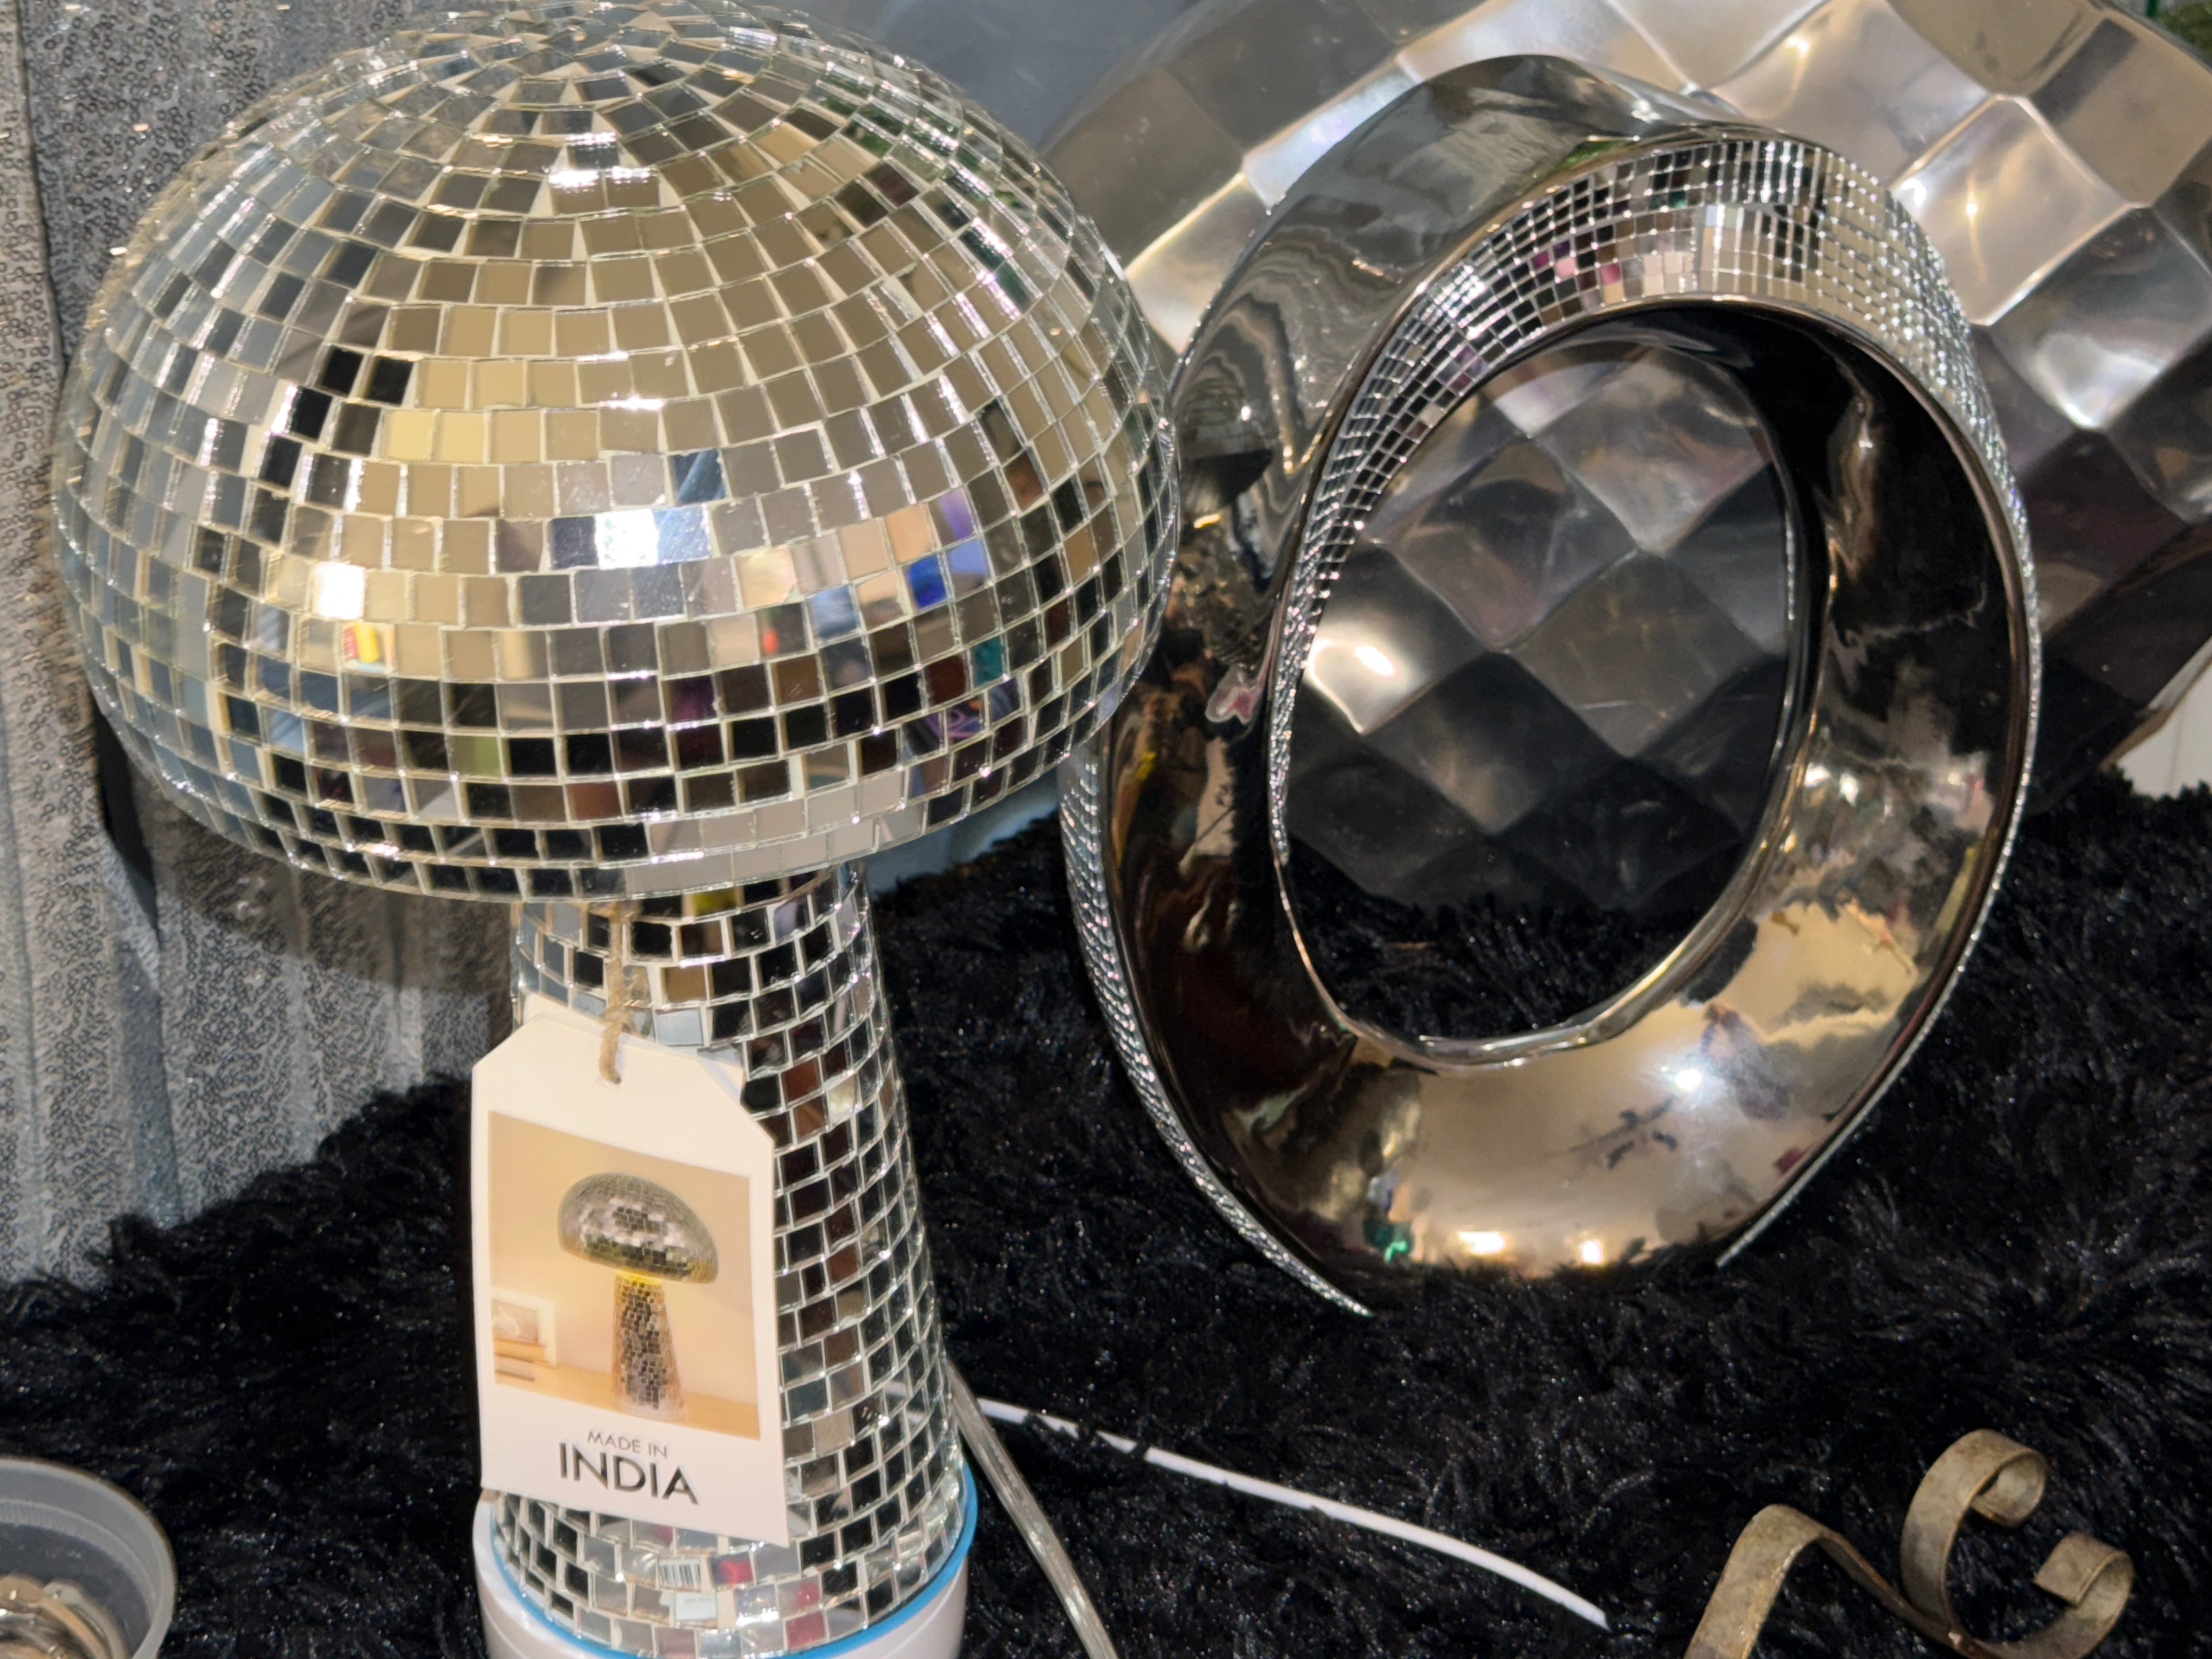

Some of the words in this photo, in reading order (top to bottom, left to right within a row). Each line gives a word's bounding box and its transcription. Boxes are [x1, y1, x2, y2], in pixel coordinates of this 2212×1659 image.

[588, 1431, 641, 1453] MADE
[648, 1444, 668, 1458] IN
[559, 1442, 700, 1505] INDIA
